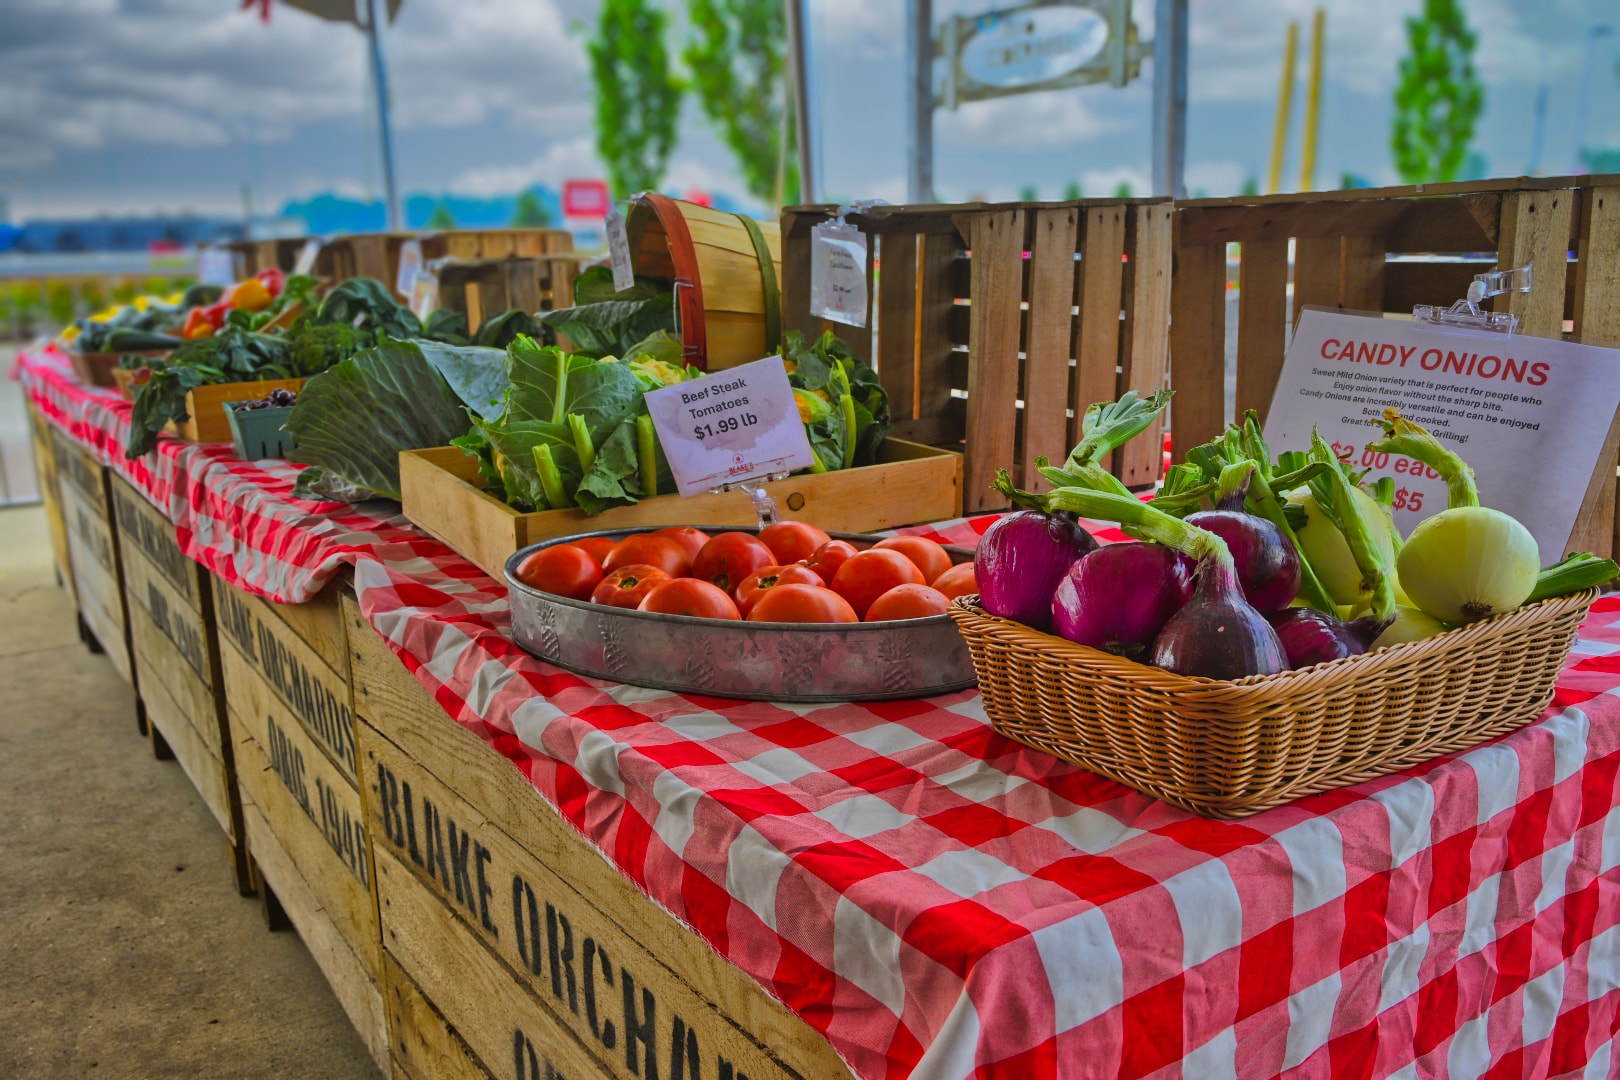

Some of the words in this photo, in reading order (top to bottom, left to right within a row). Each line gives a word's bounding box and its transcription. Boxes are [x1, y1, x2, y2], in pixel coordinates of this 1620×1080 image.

[1320, 338, 1417, 368] CANDY
[1420, 348, 1551, 387] ONIONS
[681, 387, 709, 405] Beef
[711, 378, 747, 396] Steak
[1311, 367, 1335, 377] Sweet
[1336, 371, 1353, 380] Mild
[1354, 373, 1377, 382] Onion
[1379, 376, 1408, 387] variety
[1408, 379, 1425, 388] that
[1426, 381, 1434, 389] is
[1435, 383, 1469, 394] perfect
[1470, 387, 1484, 396] for
[1485, 391, 1519, 402] people
[1521, 396, 1542, 406] who
[1333, 381, 1355, 392] Enjoy
[1355, 384, 1377, 394] onion
[1379, 386, 1401, 396] flavor
[1403, 390, 1436, 401] without
[1437, 395, 1452, 403] the
[1453, 398, 1481, 409] sharp
[1482, 401, 1504, 412] bite.
[689, 396, 750, 419] Tomatoes
[1299, 388, 1324, 399] Candy
[1325, 391, 1351, 402] Onions
[1366, 397, 1406, 410] incredibly
[1408, 403, 1445, 414] versatile
[1446, 408, 1465, 418] and
[1466, 412, 1484, 421] can
[1486, 413, 1498, 423] be
[1499, 418, 1540, 431] enjoyed
[1362, 407, 1380, 417] Both
[1415, 416, 1450, 427] cooked.
[694, 417, 739, 441] $1.99
[740, 412, 758, 427] lb
[1341, 416, 1362, 425] Great
[1432, 429, 1469, 444] Grilling!
[1330, 440, 1390, 470] $2.00
[1394, 456, 1446, 482] eac
[1392, 486, 1425, 512] $5
[257, 617, 357, 776] ORCHARDS
[377, 761, 499, 939] BLAKE
[512, 874, 749, 1080] ORCHA
